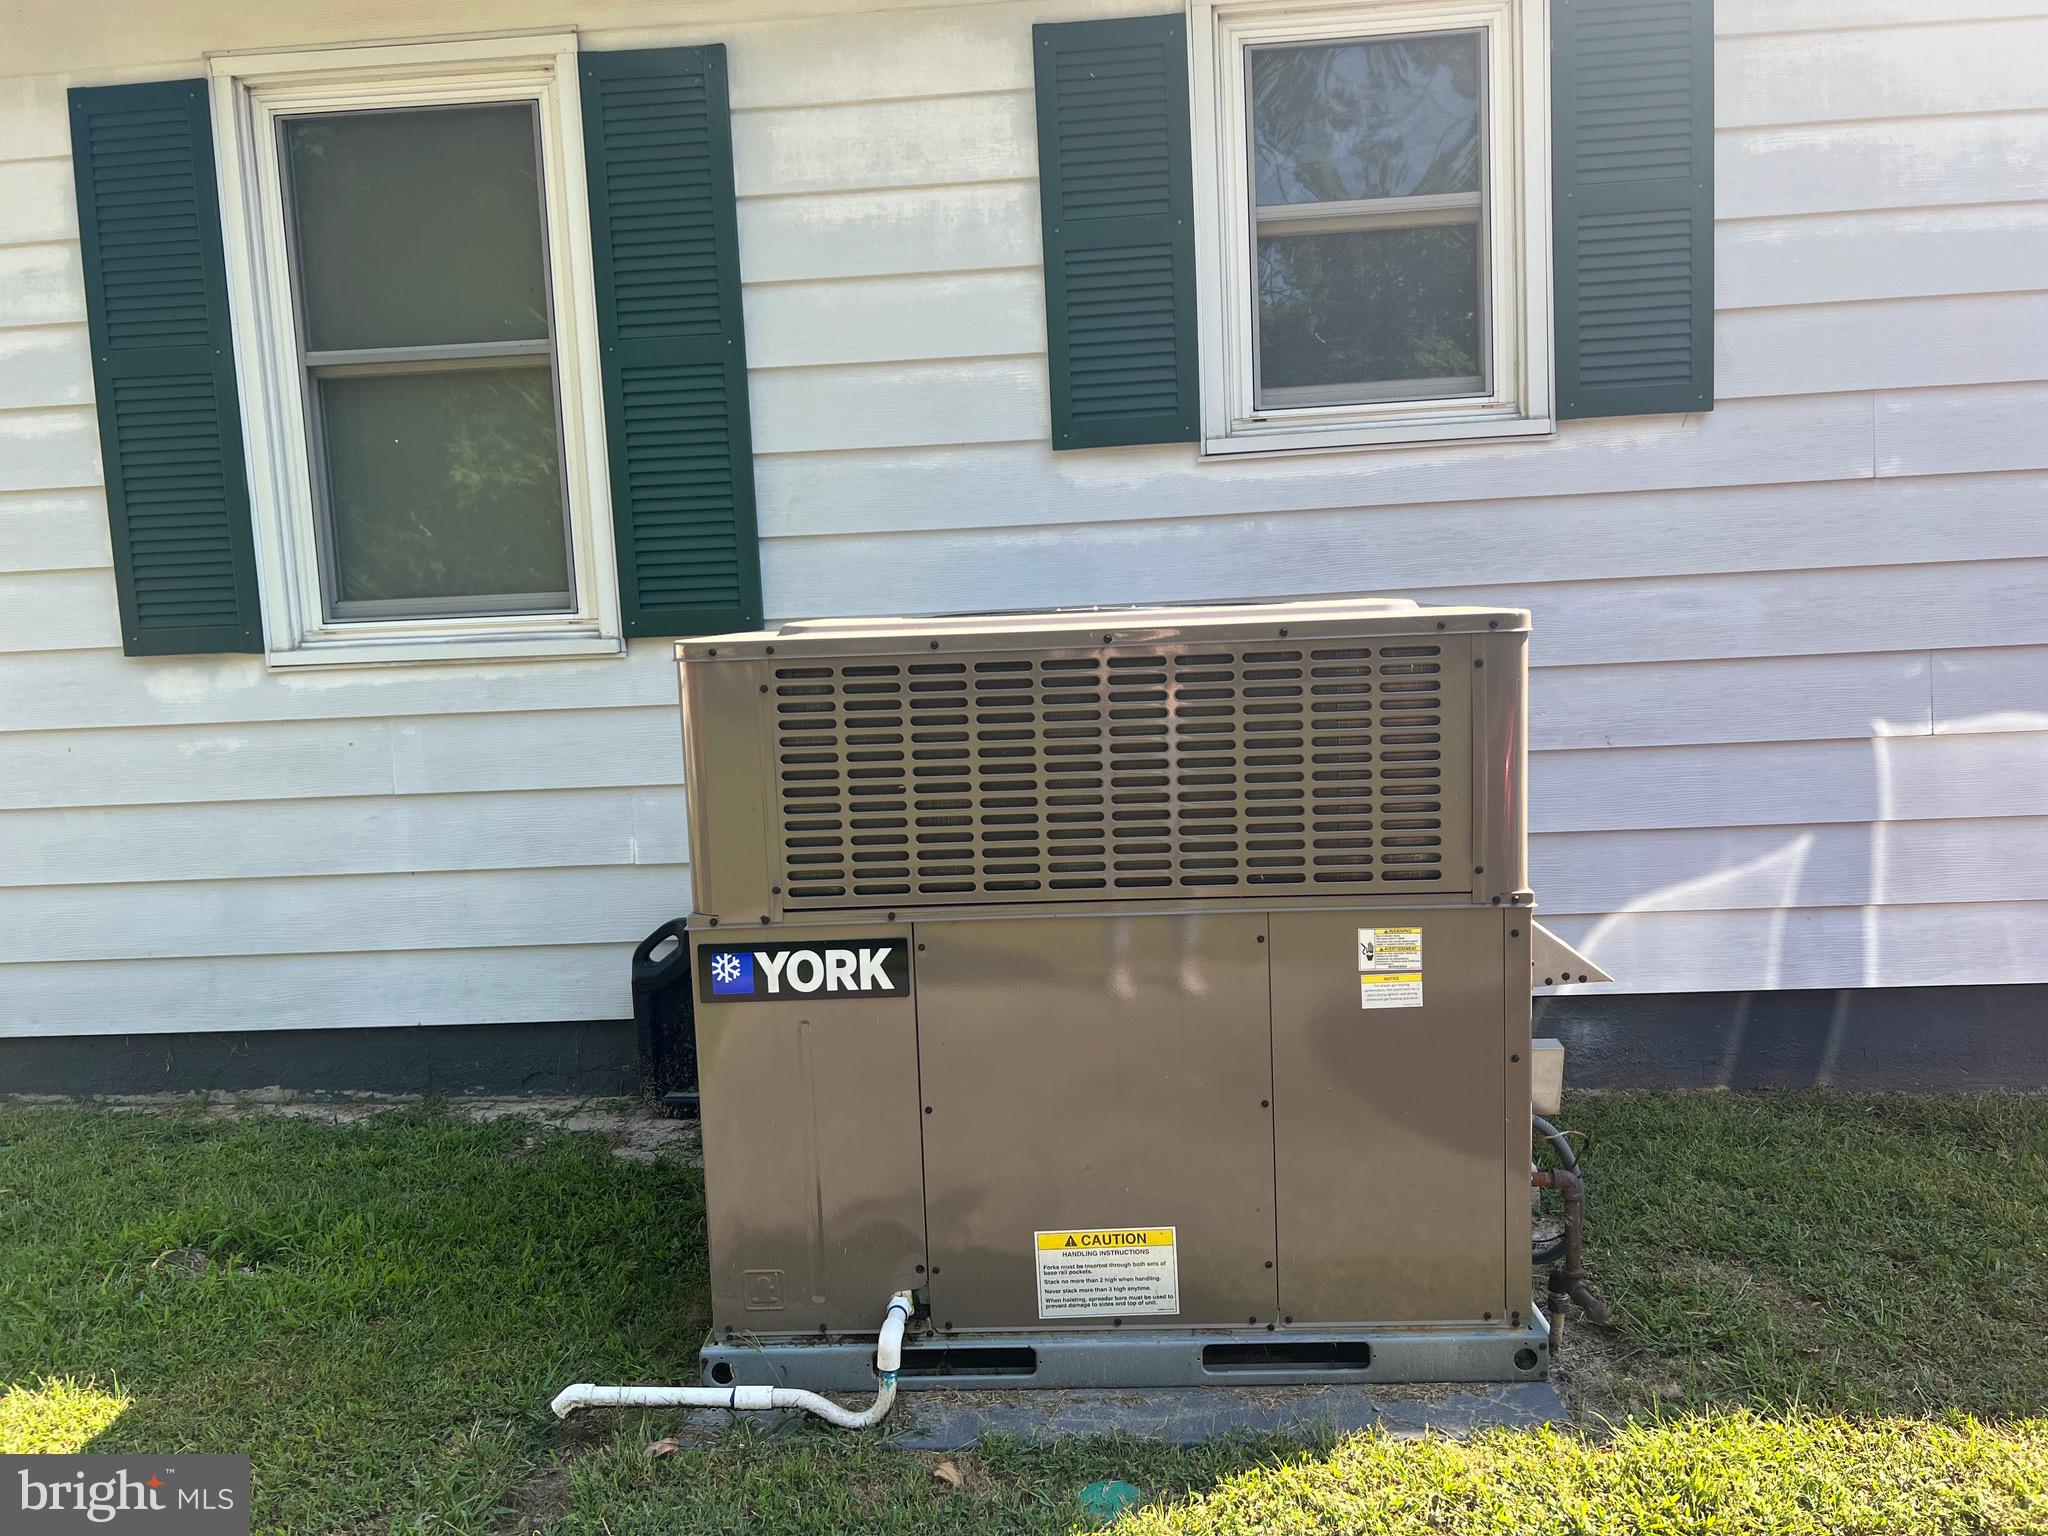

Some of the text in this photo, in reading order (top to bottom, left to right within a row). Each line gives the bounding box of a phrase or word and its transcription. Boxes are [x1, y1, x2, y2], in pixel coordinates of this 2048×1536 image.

[753, 947, 896, 993] YORK
[1081, 1233, 1147, 1246] CAUTION
[1099, 1248, 1150, 1256] INSTRUCTIONS
